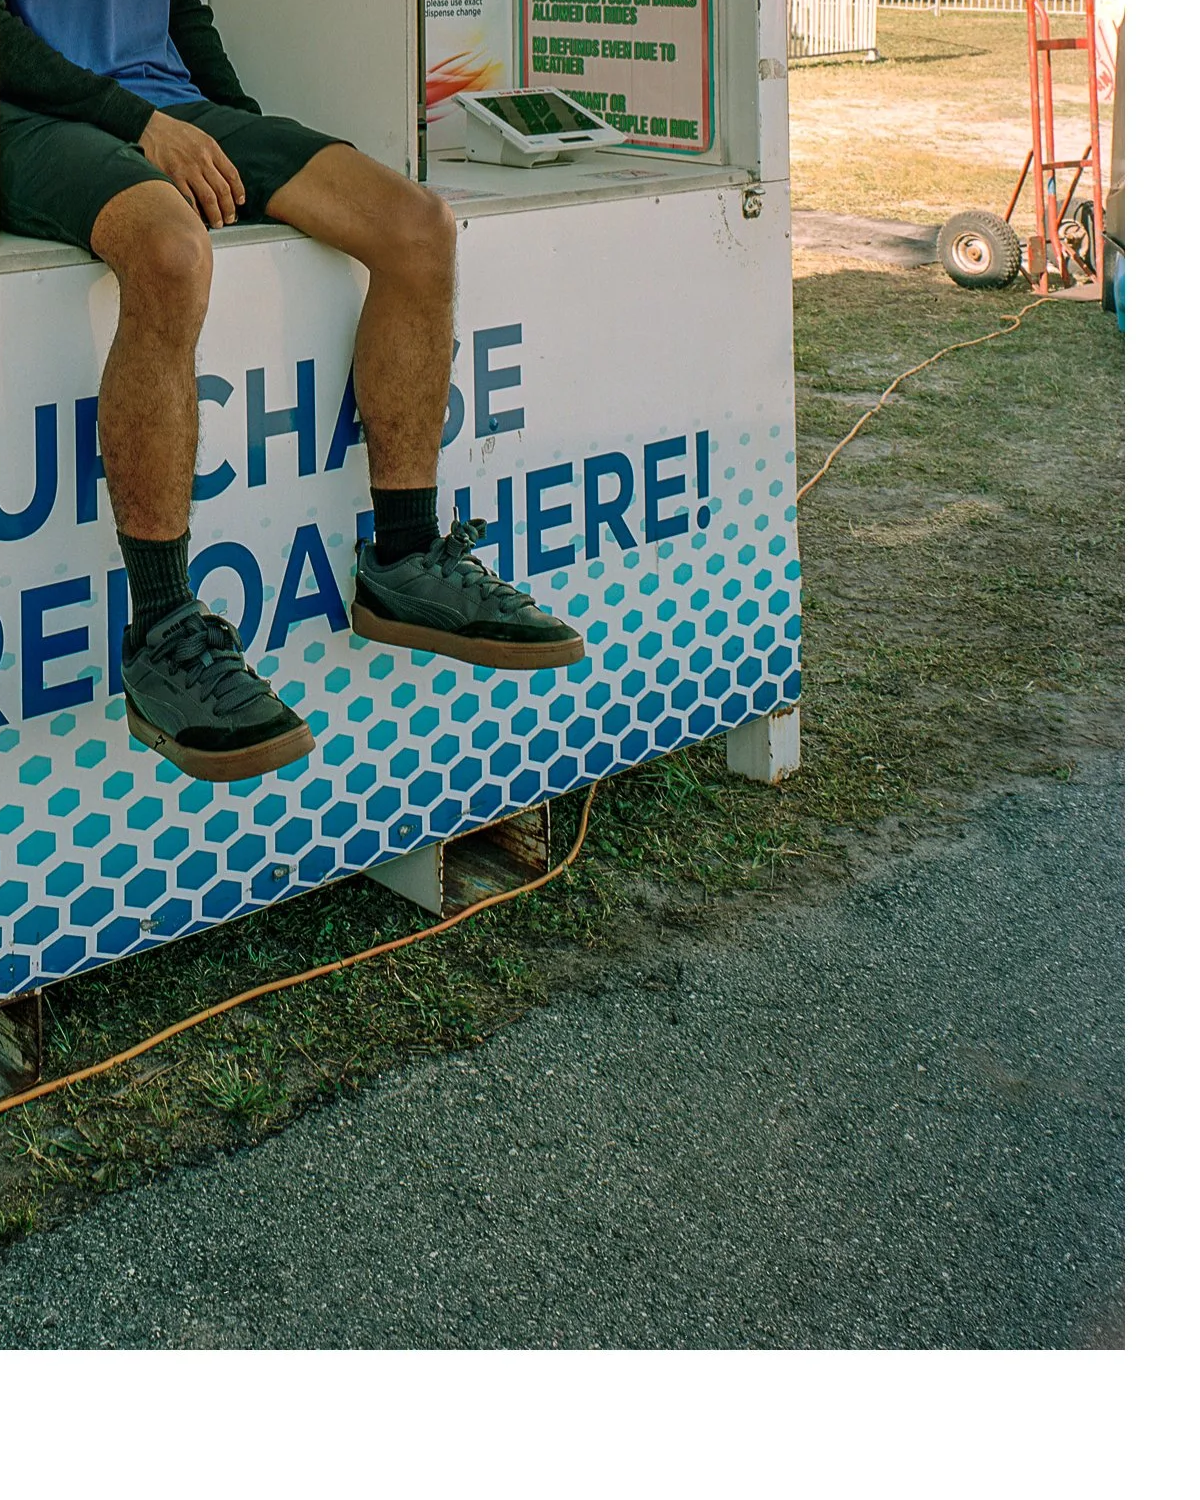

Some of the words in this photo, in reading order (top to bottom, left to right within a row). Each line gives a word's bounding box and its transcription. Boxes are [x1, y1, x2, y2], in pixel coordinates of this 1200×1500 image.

[456, 7, 482, 18] change
[531, 3, 583, 23] ALLOWED
[585, 4, 602, 24] ON
[603, 5, 638, 25] RIDES
[532, 36, 548, 55] NO
[549, 37, 600, 58] REFUNDS
[601, 40, 632, 60] EVEN
[633, 41, 658, 62] DUE
[659, 43, 676, 63] TO
[532, 54, 584, 76] WEATHER
[610, 93, 626, 113] OR
[605, 113, 649, 135] PEOPLE
[650, 116, 668, 137] ON
[669, 118, 699, 140] RIDE
[454, 430, 711, 583] HERE!
